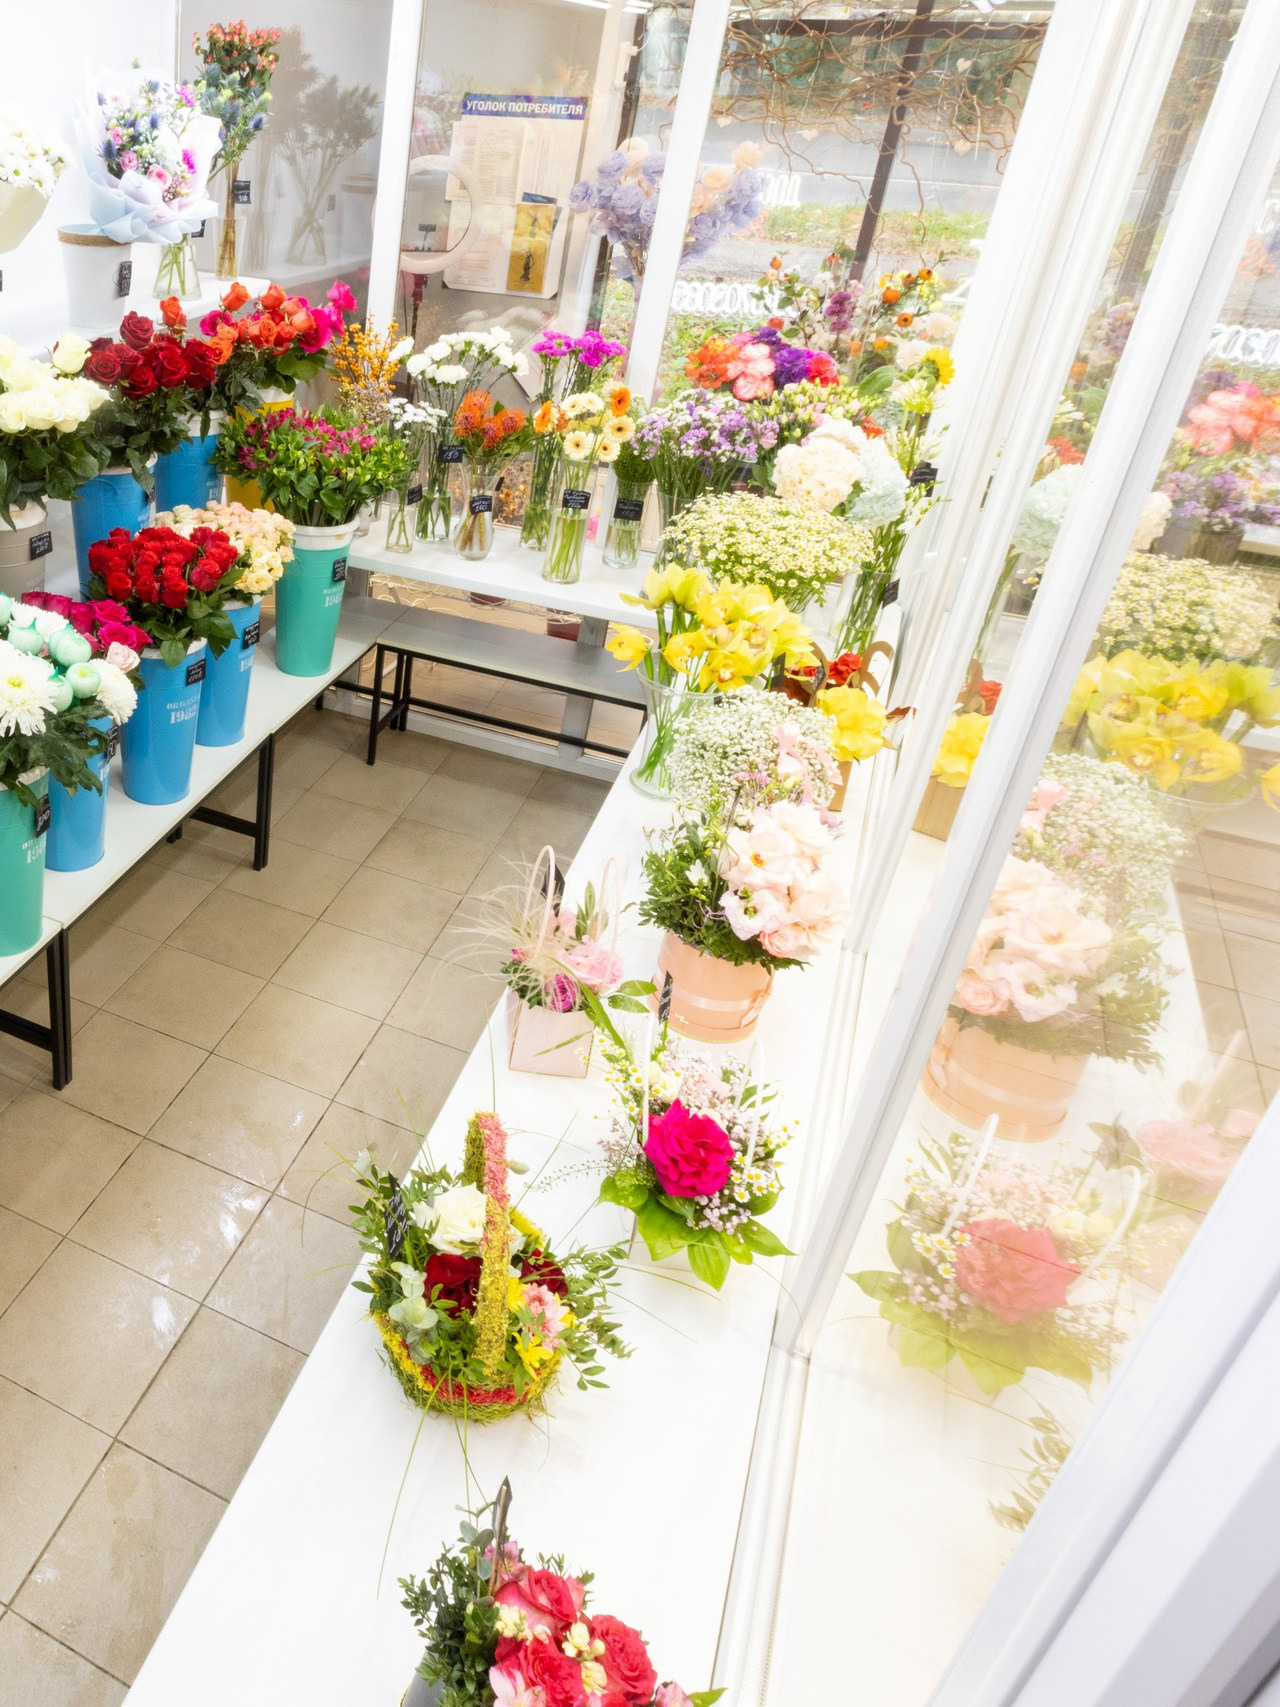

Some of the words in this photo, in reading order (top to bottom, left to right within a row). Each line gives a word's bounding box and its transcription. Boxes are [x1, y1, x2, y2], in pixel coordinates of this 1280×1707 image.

[466, 100, 506, 112] УГОЛОК
[507, 101, 584, 115] ПОТРЕБИТЕЛЯ
[444, 450, 459, 460] 150
